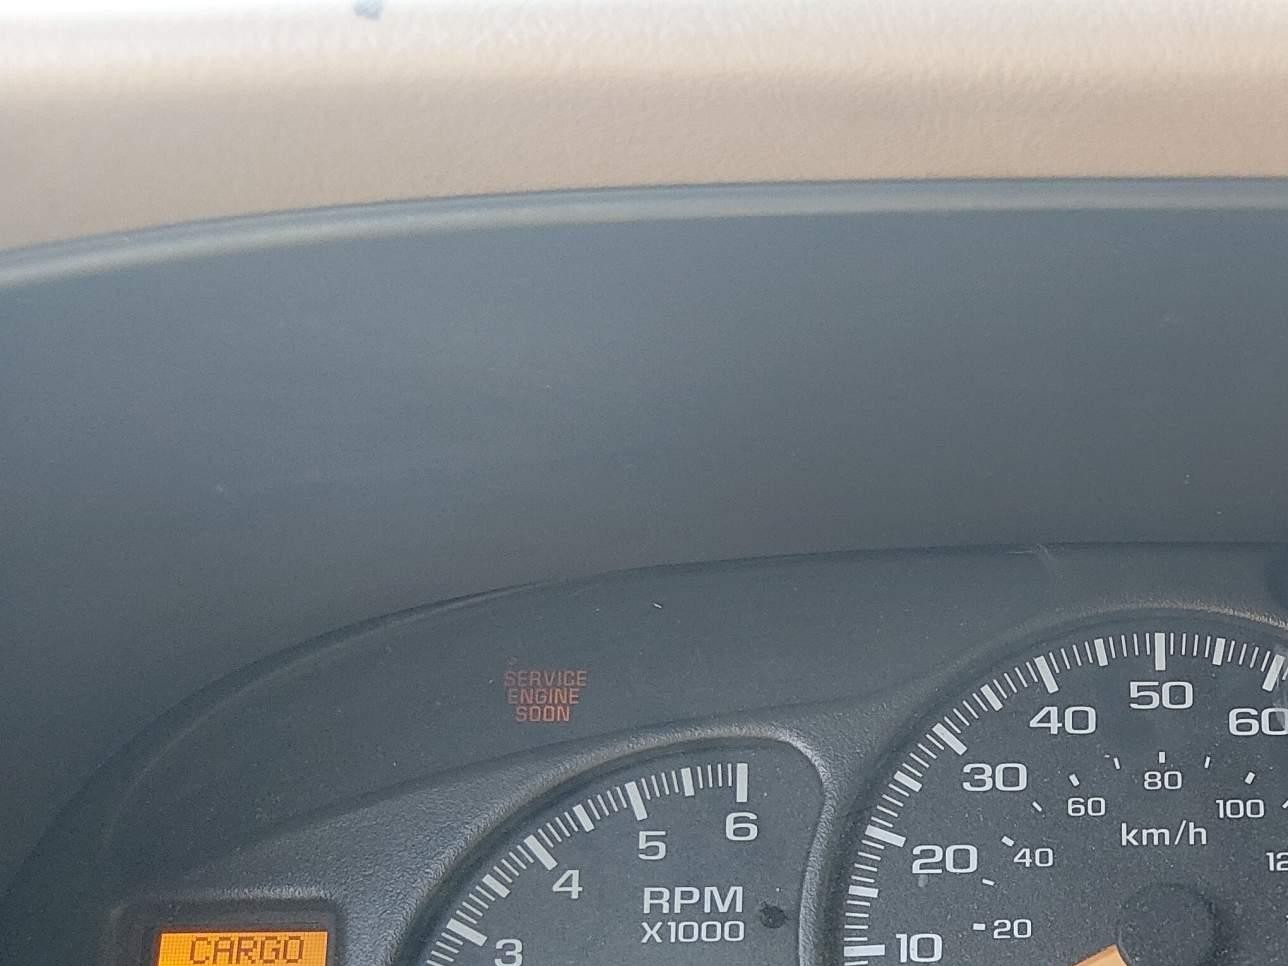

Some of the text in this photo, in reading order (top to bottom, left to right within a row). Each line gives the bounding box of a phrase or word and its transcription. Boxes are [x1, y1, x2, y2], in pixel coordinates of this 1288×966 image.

[505, 671, 587, 687] SERVICE
[508, 688, 580, 704] ENGINE
[1130, 682, 1192, 709] 50
[516, 705, 570, 722] SOON
[1030, 707, 1096, 734] 40
[963, 763, 1027, 791] 30
[1144, 771, 1181, 789] 80
[1068, 798, 1105, 816] 60
[1216, 800, 1264, 818] 100
[726, 812, 757, 840] 6
[1122, 820, 1206, 845] km/h
[639, 831, 665, 859] 5
[1014, 848, 1054, 867] 40
[912, 845, 977, 873] 20
[554, 870, 583, 898] 4
[644, 887, 742, 913] RPM
[642, 921, 744, 942] X1000
[994, 919, 1031, 938] 20
[190, 936, 304, 965] CARGO
[896, 934, 942, 962] 10
